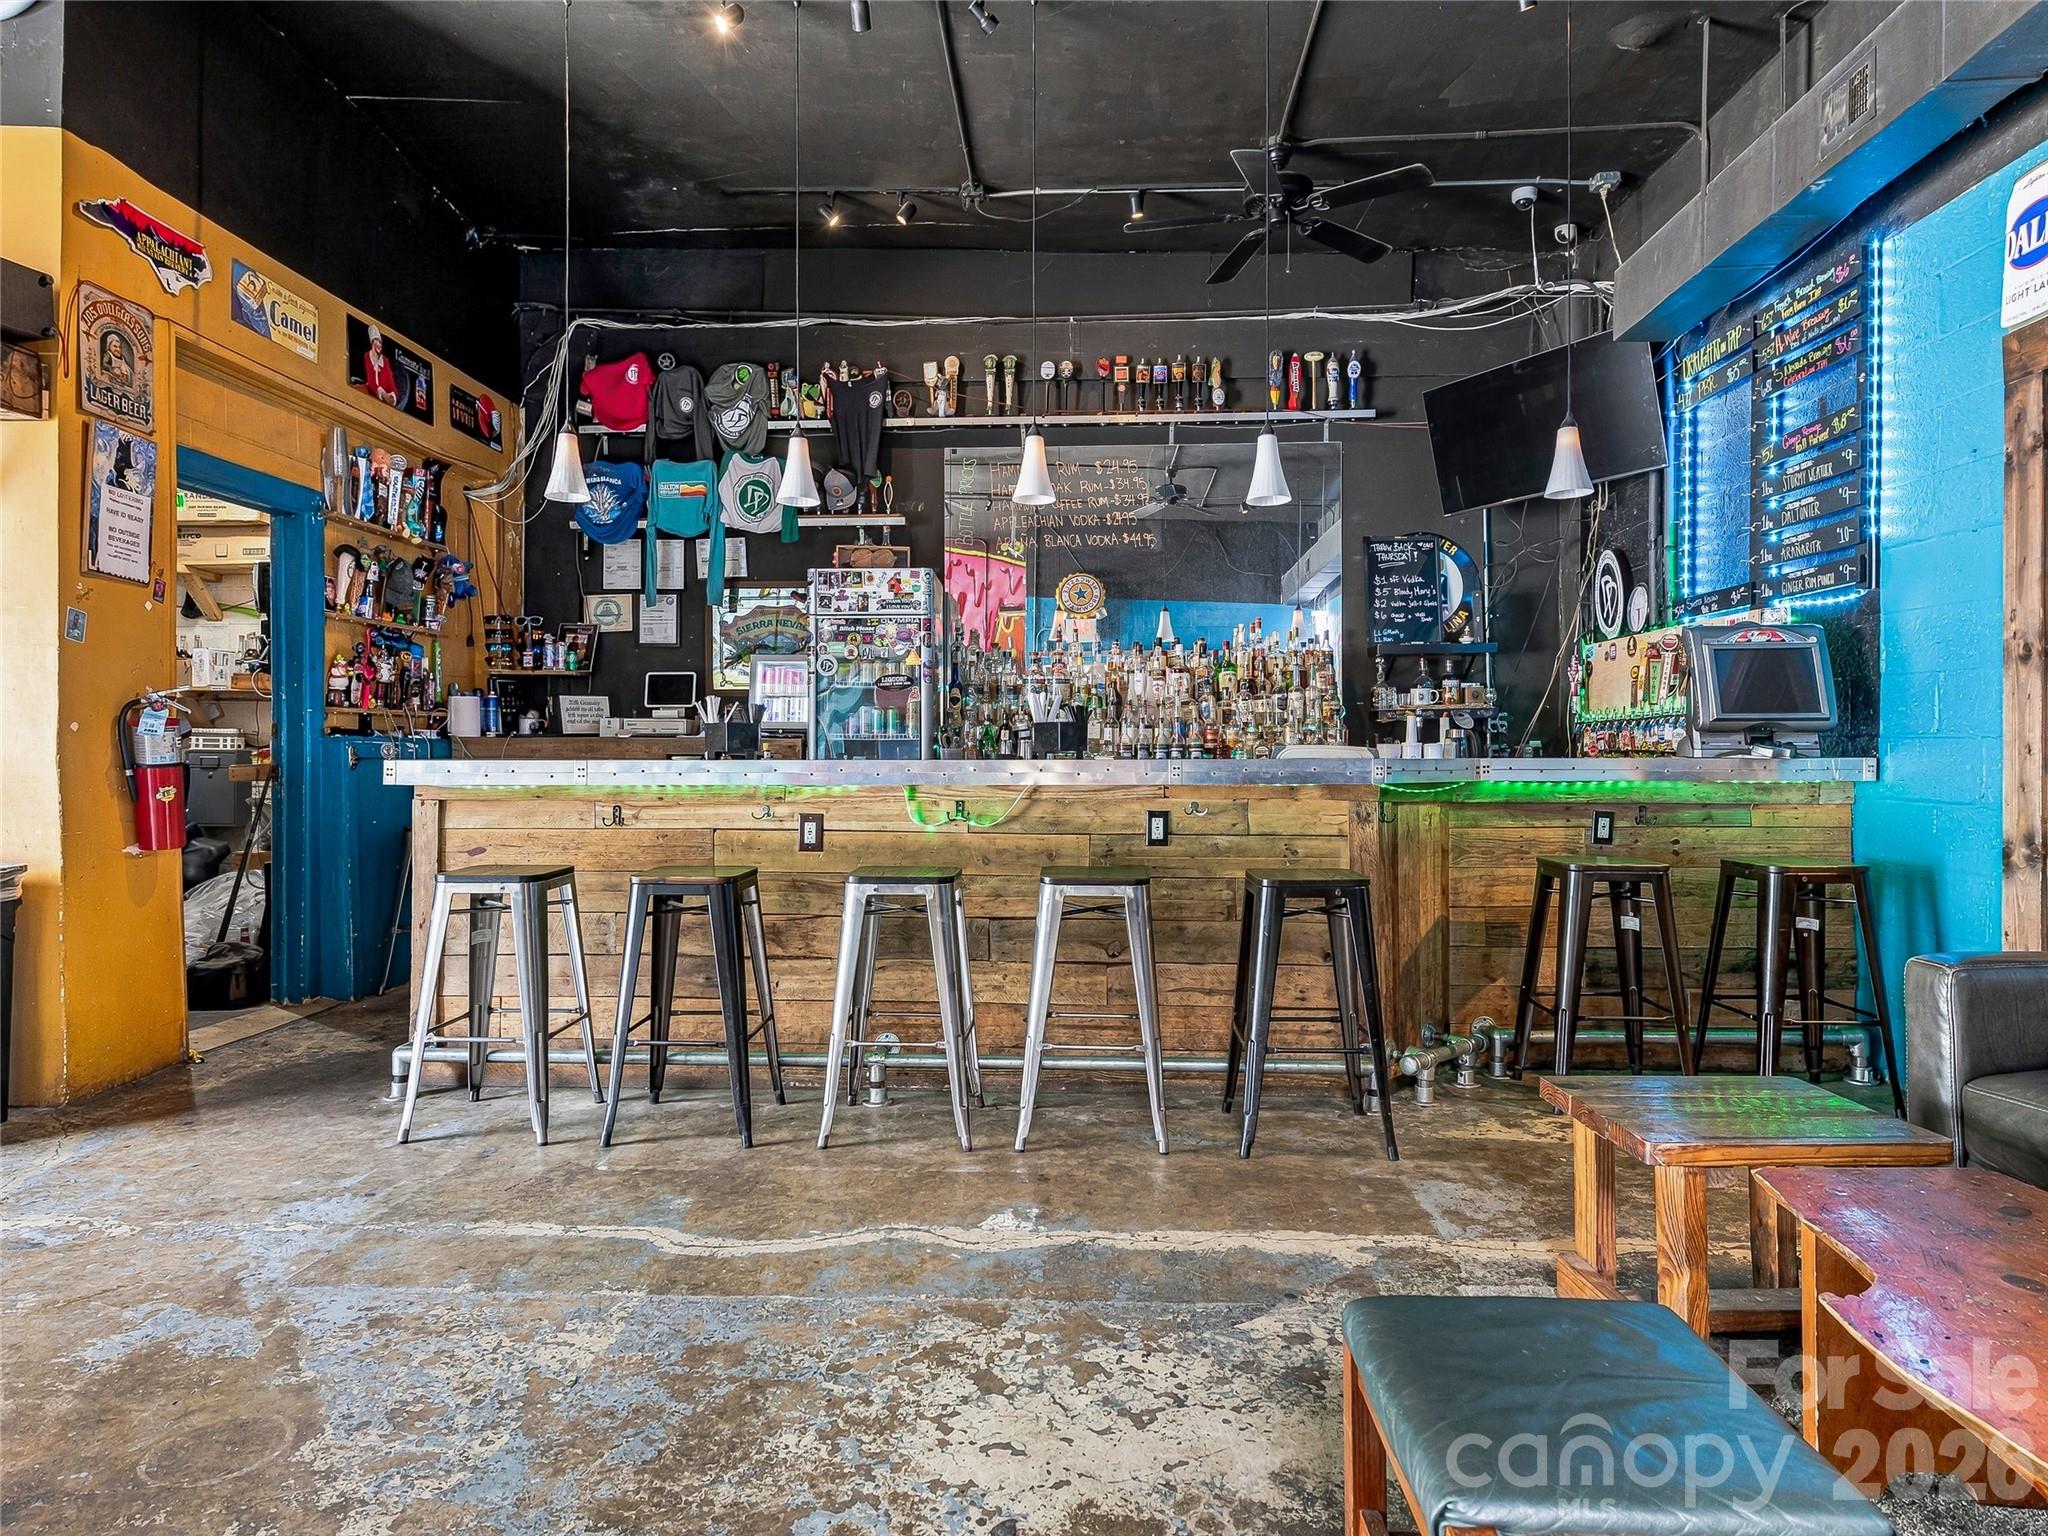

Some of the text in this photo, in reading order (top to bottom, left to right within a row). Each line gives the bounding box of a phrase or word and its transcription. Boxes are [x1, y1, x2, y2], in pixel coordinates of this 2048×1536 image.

[270, 300, 317, 344] Camel
[1697, 374, 1718, 401] PBR
[89, 383, 148, 420] LAGER BEER
[1055, 461, 1082, 477] RUM
[1807, 462, 1833, 482] WEATHER
[105, 506, 120, 517] HAVE
[1068, 514, 1101, 527] VODKA
[108, 525, 141, 540] NO OUTSIDE
[107, 534, 140, 548] BEVERAGES
[1043, 534, 1083, 549] BLANCA
[1085, 532, 1119, 547] VODKA
[1373, 574, 1388, 586] $1
[1781, 579, 1804, 596] GINGER
[1374, 587, 1391, 597] $5
[1373, 598, 1387, 608] $2
[880, 617, 921, 625] OLYMPIA
[1374, 610, 1387, 620] $6
[735, 620, 774, 635] SIERRA
